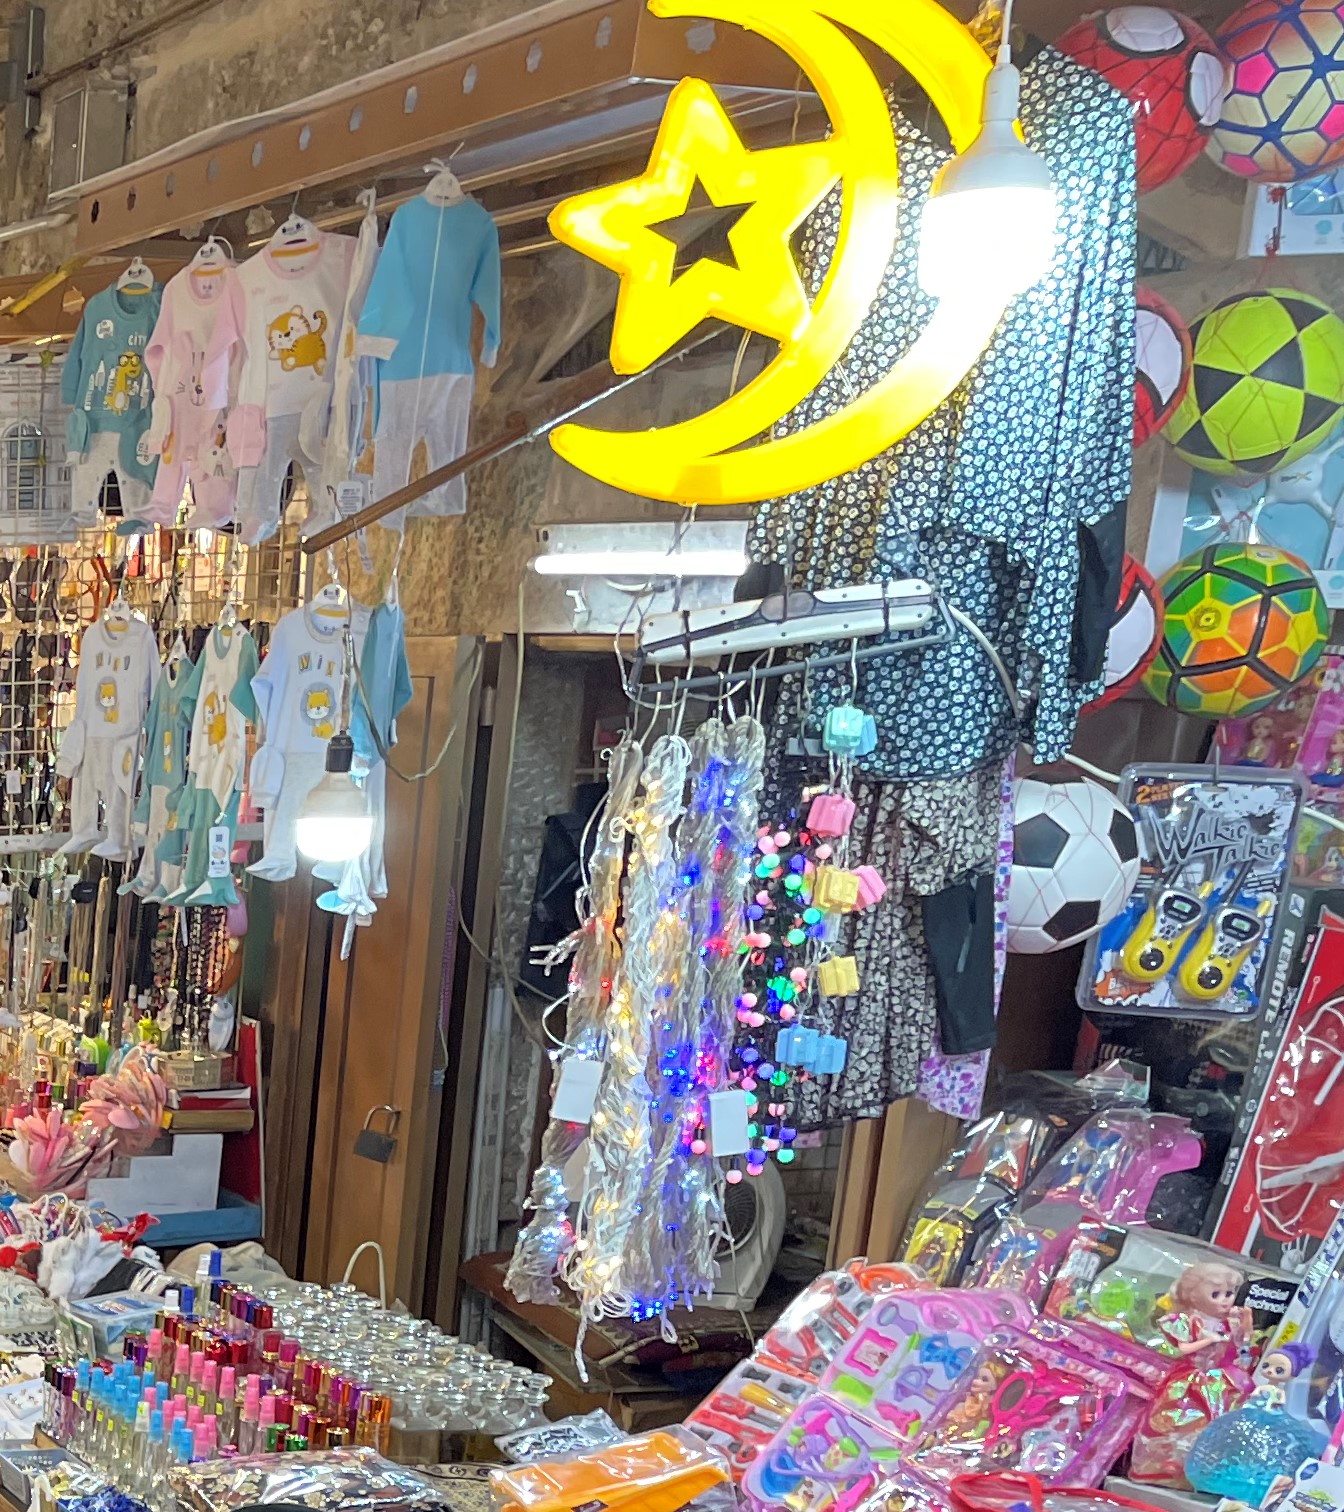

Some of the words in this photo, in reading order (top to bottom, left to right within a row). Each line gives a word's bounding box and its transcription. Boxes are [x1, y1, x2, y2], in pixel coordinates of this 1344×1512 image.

[1148, 806, 1247, 863] Walkie
[1192, 833, 1280, 877] Talkie
[1264, 928, 1297, 1024] REMOTE
[1248, 1283, 1290, 1301] Special
